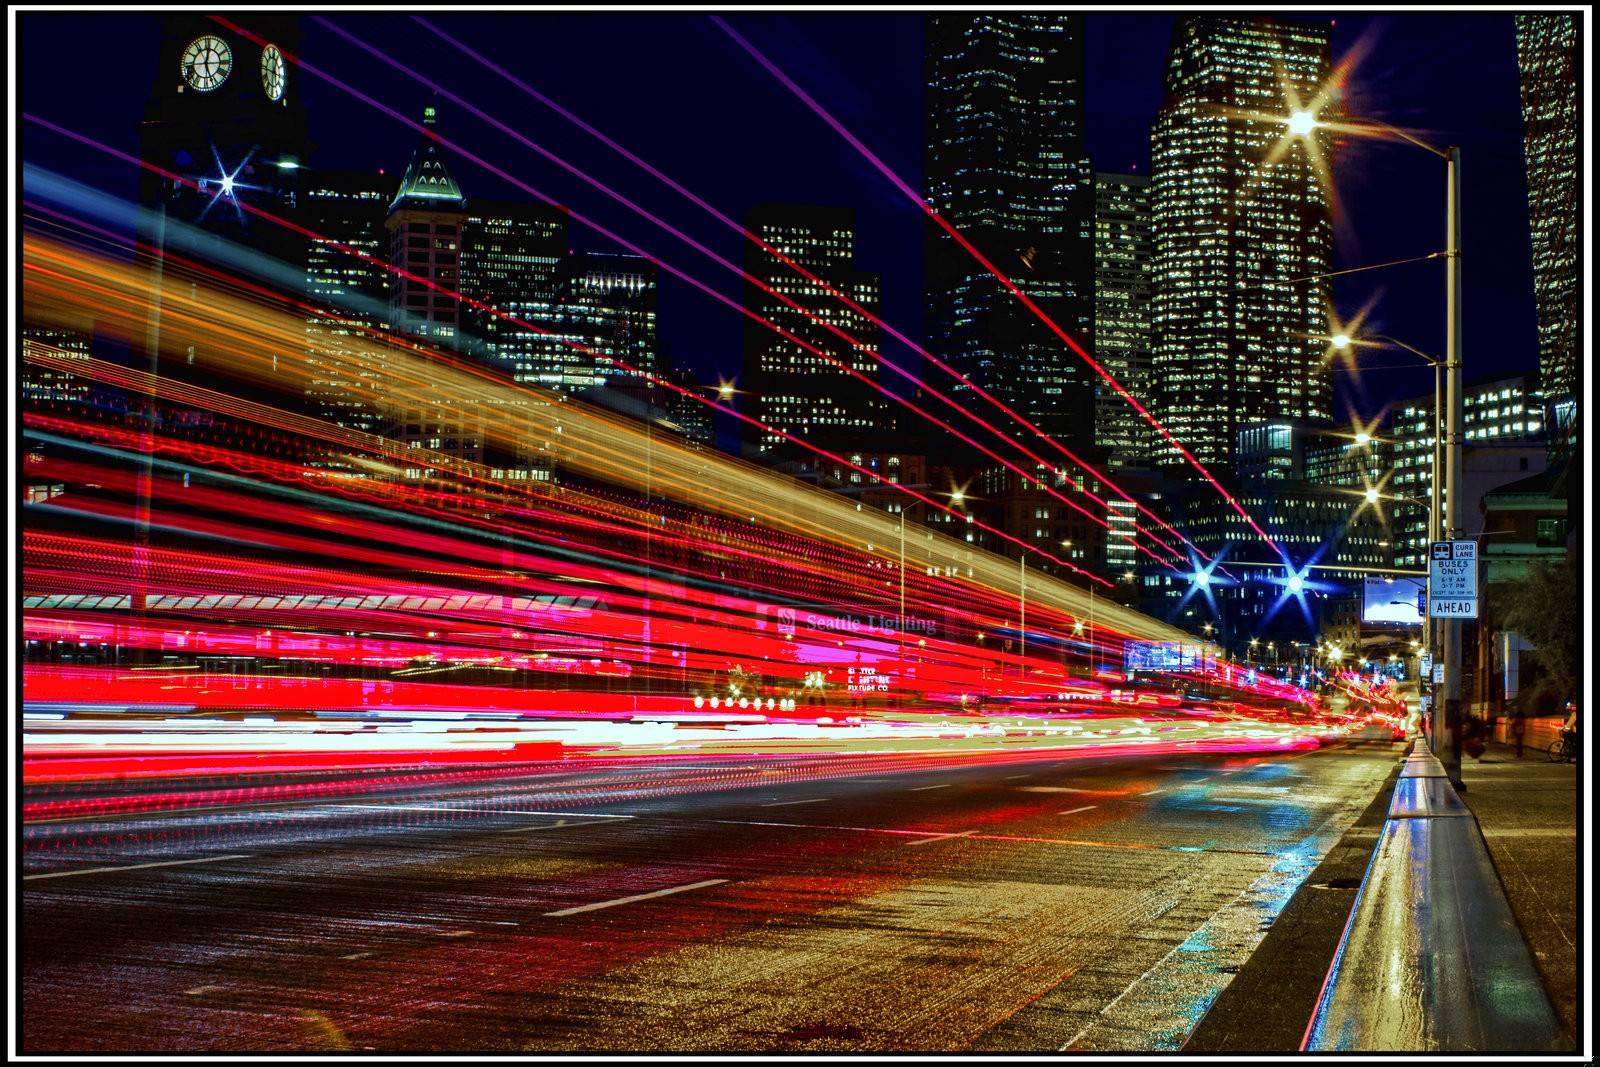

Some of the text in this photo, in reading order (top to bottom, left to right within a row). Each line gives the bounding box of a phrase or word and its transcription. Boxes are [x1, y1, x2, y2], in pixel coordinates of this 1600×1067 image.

[1438, 560, 1469, 568] BUSES
[1436, 602, 1471, 613] AHEAD
[806, 614, 860, 632] Seattle
